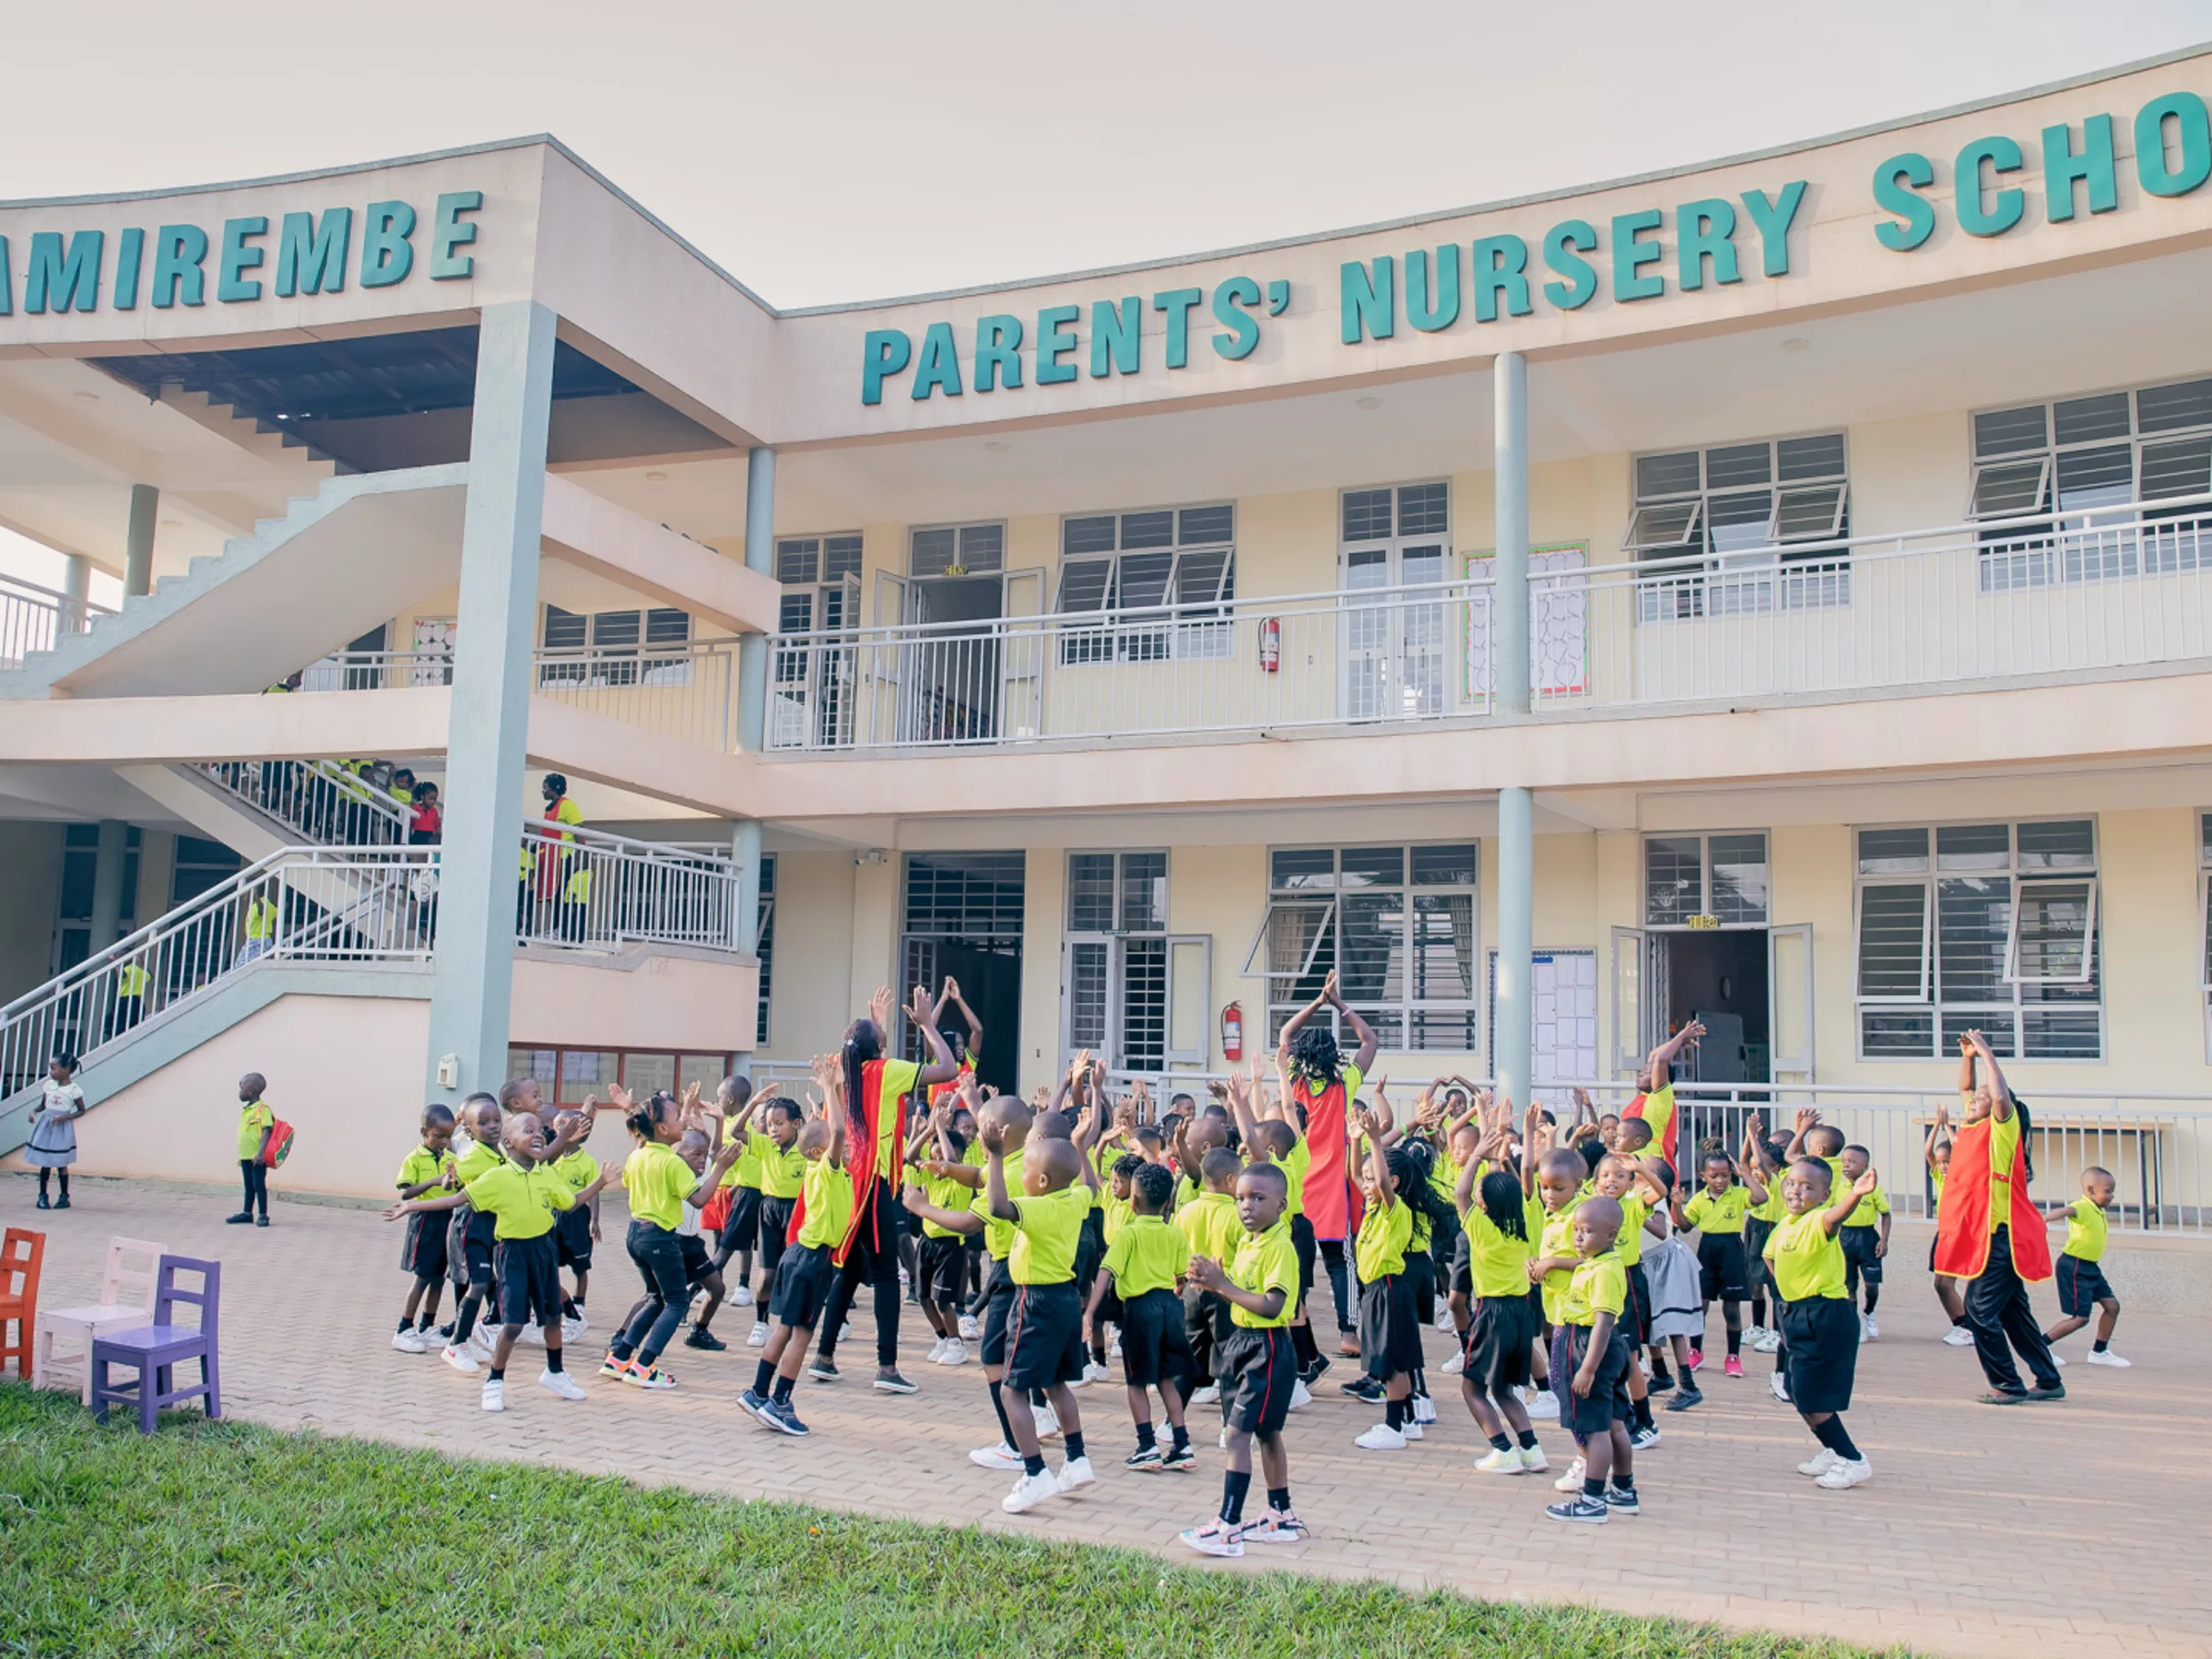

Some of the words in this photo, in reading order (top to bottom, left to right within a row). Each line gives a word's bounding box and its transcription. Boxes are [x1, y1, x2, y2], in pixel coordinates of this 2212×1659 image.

[0, 191, 484, 316] MIREMBE
[1340, 180, 1809, 345] NURSERY
[1873, 91, 2212, 250] SCHO
